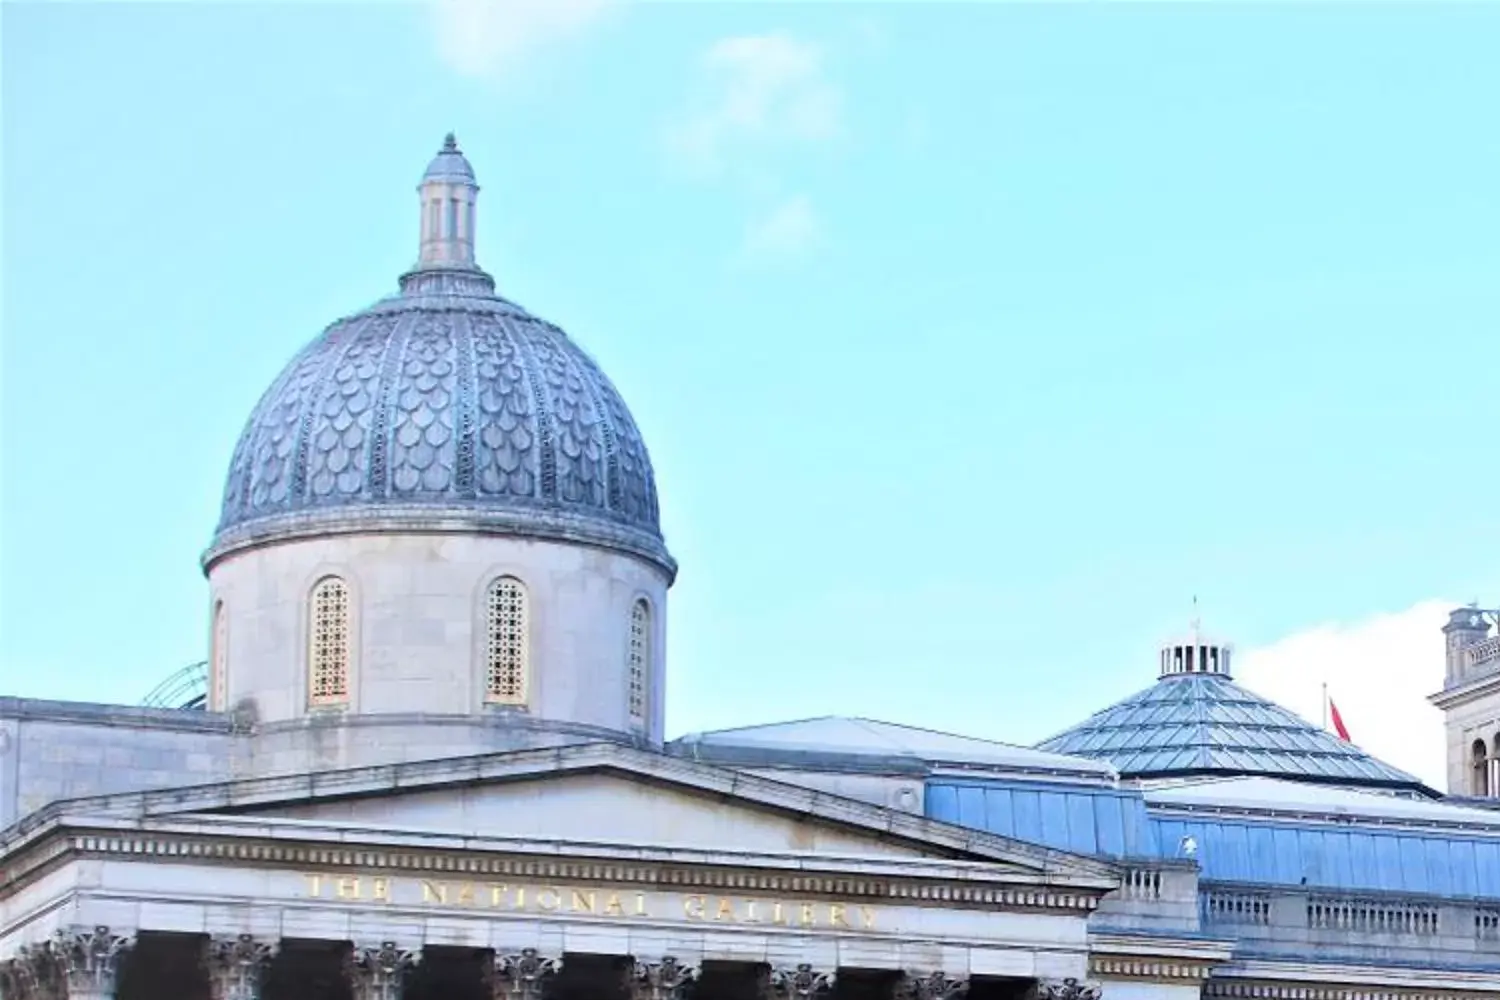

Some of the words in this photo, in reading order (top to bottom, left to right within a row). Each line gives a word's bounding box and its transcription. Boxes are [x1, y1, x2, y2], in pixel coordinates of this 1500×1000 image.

[304, 873, 389, 901] THE
[417, 878, 648, 917] NATIONAL
[684, 894, 877, 930] GALLERY
